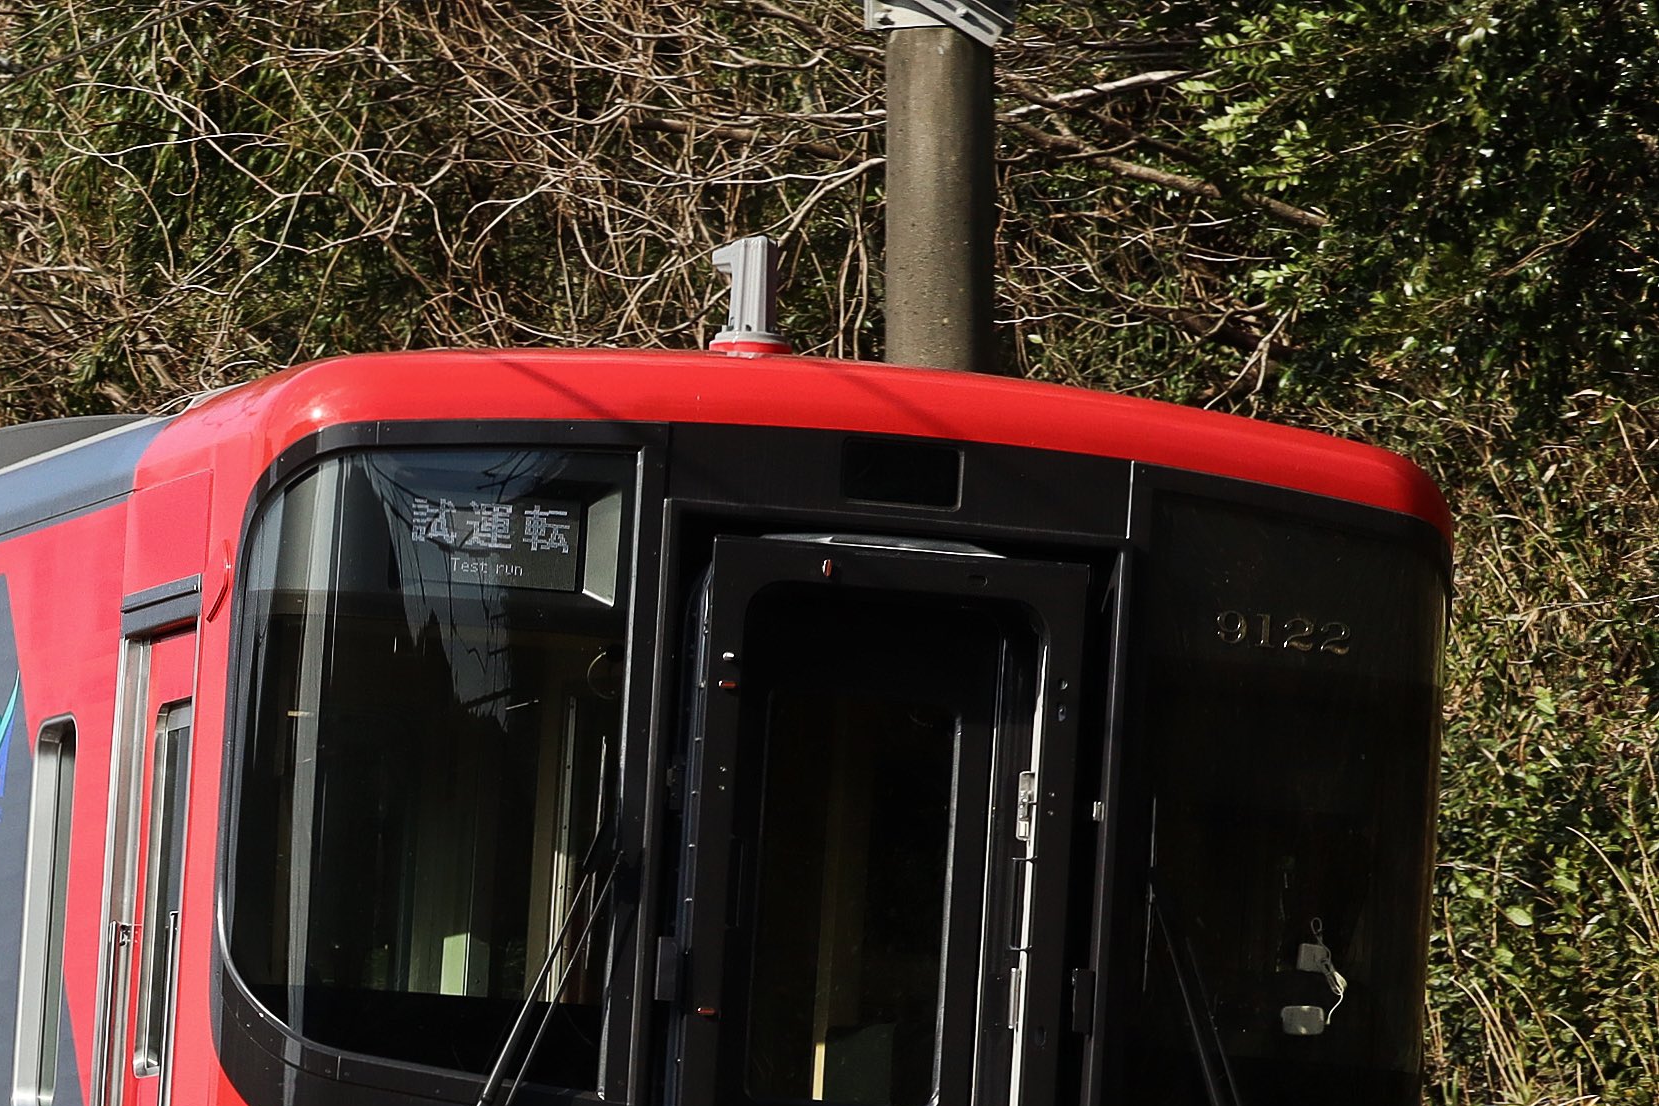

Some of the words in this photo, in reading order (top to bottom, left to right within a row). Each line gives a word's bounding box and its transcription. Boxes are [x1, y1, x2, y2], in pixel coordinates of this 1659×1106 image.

[411, 498, 571, 554] 試運転
[450, 556, 488, 575] Test
[495, 563, 523, 577] run
[1216, 610, 1351, 655] 9122
